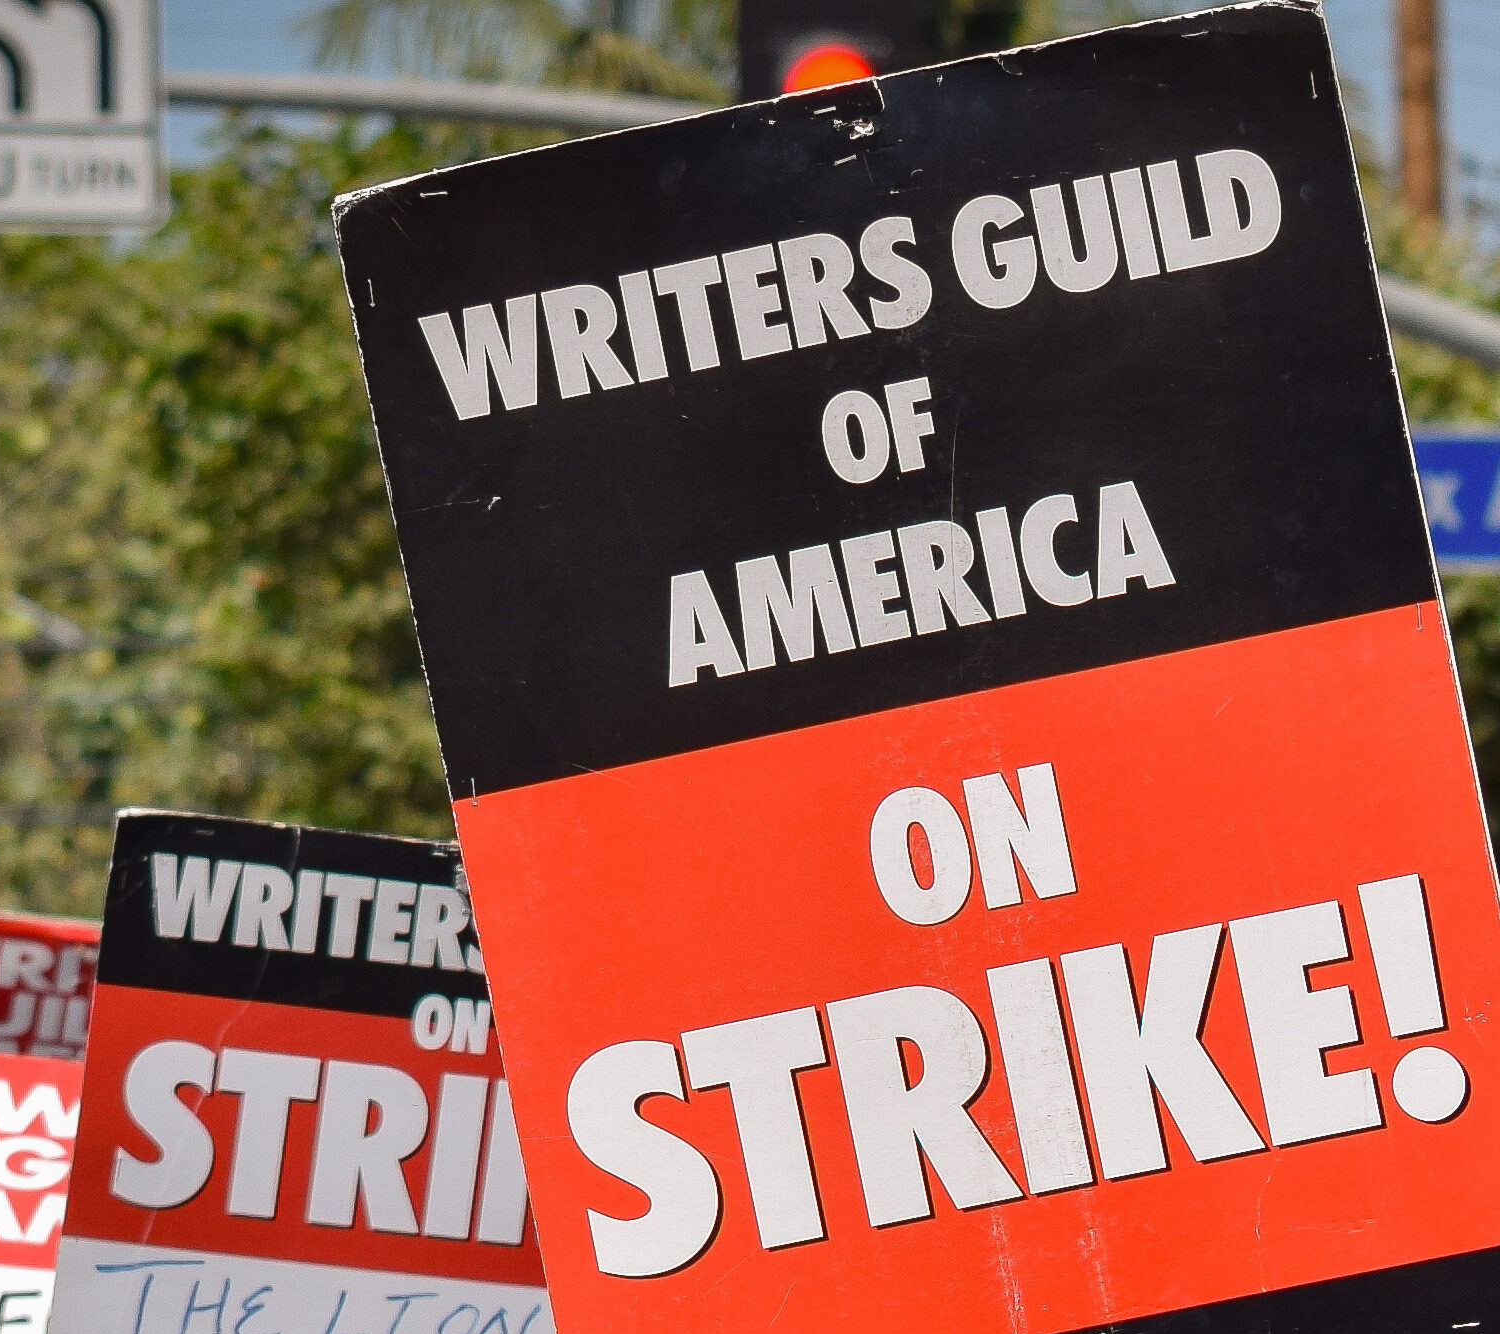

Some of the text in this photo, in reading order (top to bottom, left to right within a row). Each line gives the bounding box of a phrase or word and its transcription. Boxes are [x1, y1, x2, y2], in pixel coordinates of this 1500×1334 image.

[417, 148, 1283, 421] WRITERS GUILD
[820, 375, 937, 486] OF
[667, 479, 1177, 689] AMERICA
[151, 853, 485, 975] WRITER
[869, 761, 1077, 927] ON
[411, 993, 490, 1053] ON
[564, 872, 1472, 1280] STRIKE!
[110, 1038, 529, 1247] STRI
